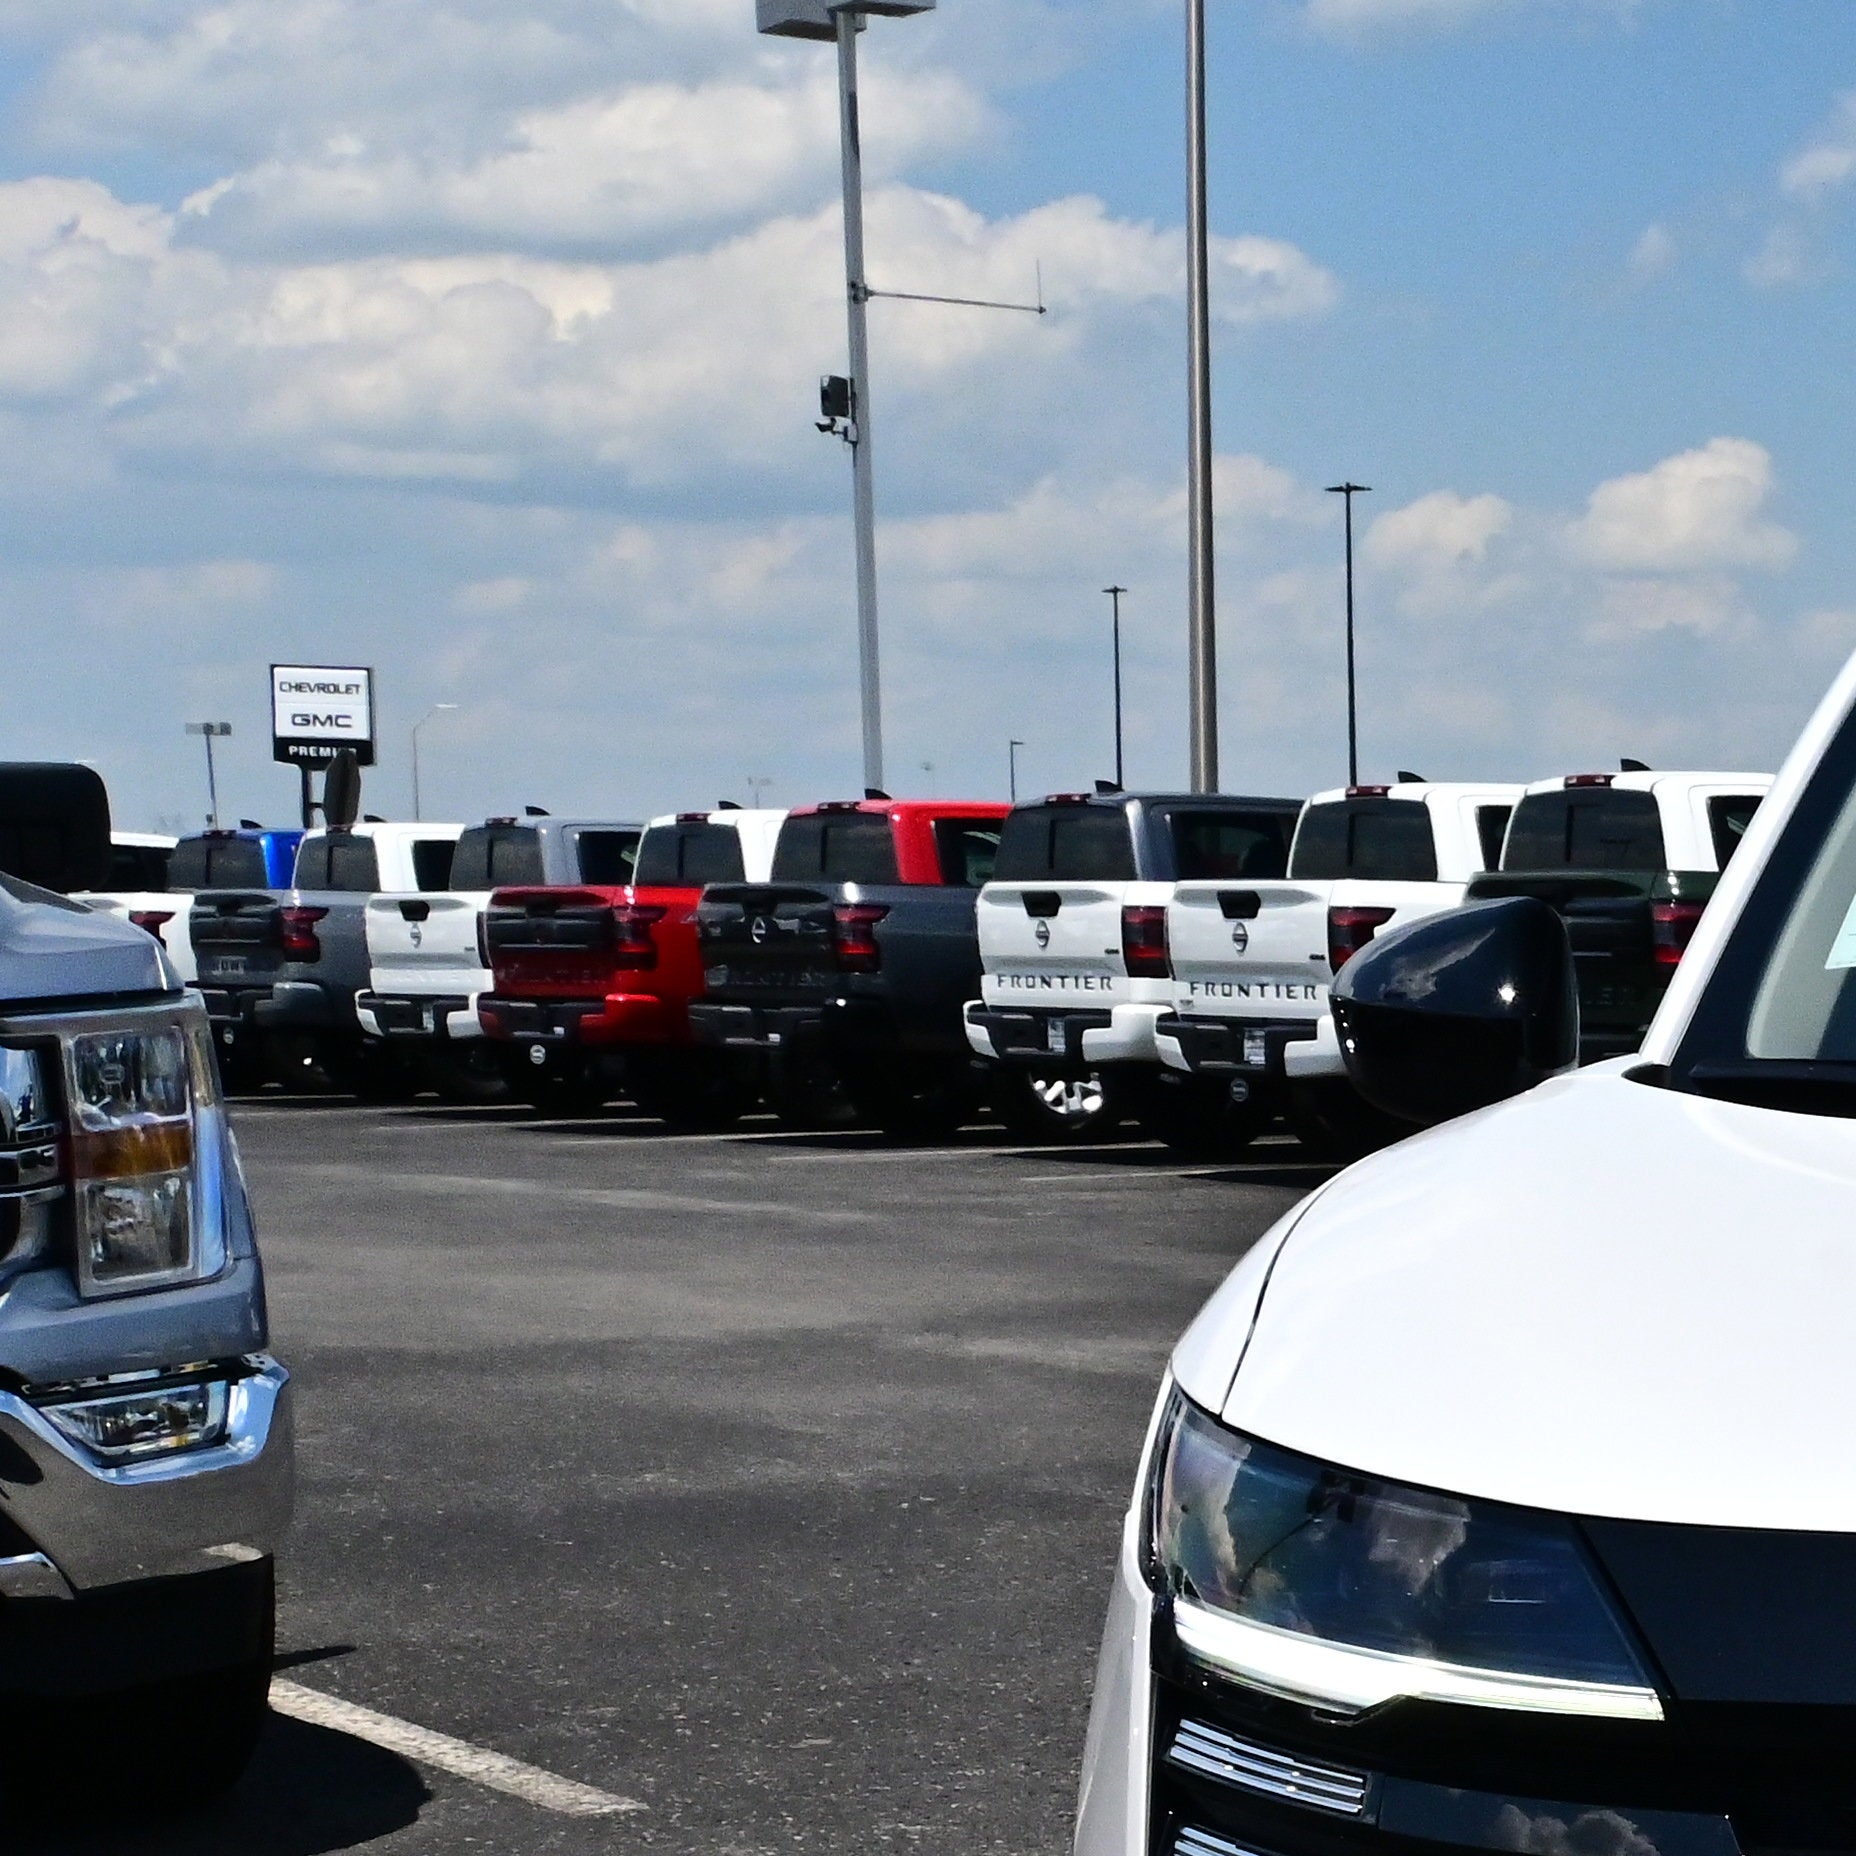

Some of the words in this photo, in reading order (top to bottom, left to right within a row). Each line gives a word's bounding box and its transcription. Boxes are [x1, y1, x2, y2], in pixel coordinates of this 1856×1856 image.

[279, 681, 360, 695] CHEVROLET
[292, 713, 353, 728] GMC
[288, 745, 357, 759] PREMI
[997, 974, 1113, 990] FRONTIER
[1190, 981, 1317, 1000] FRONTIER
